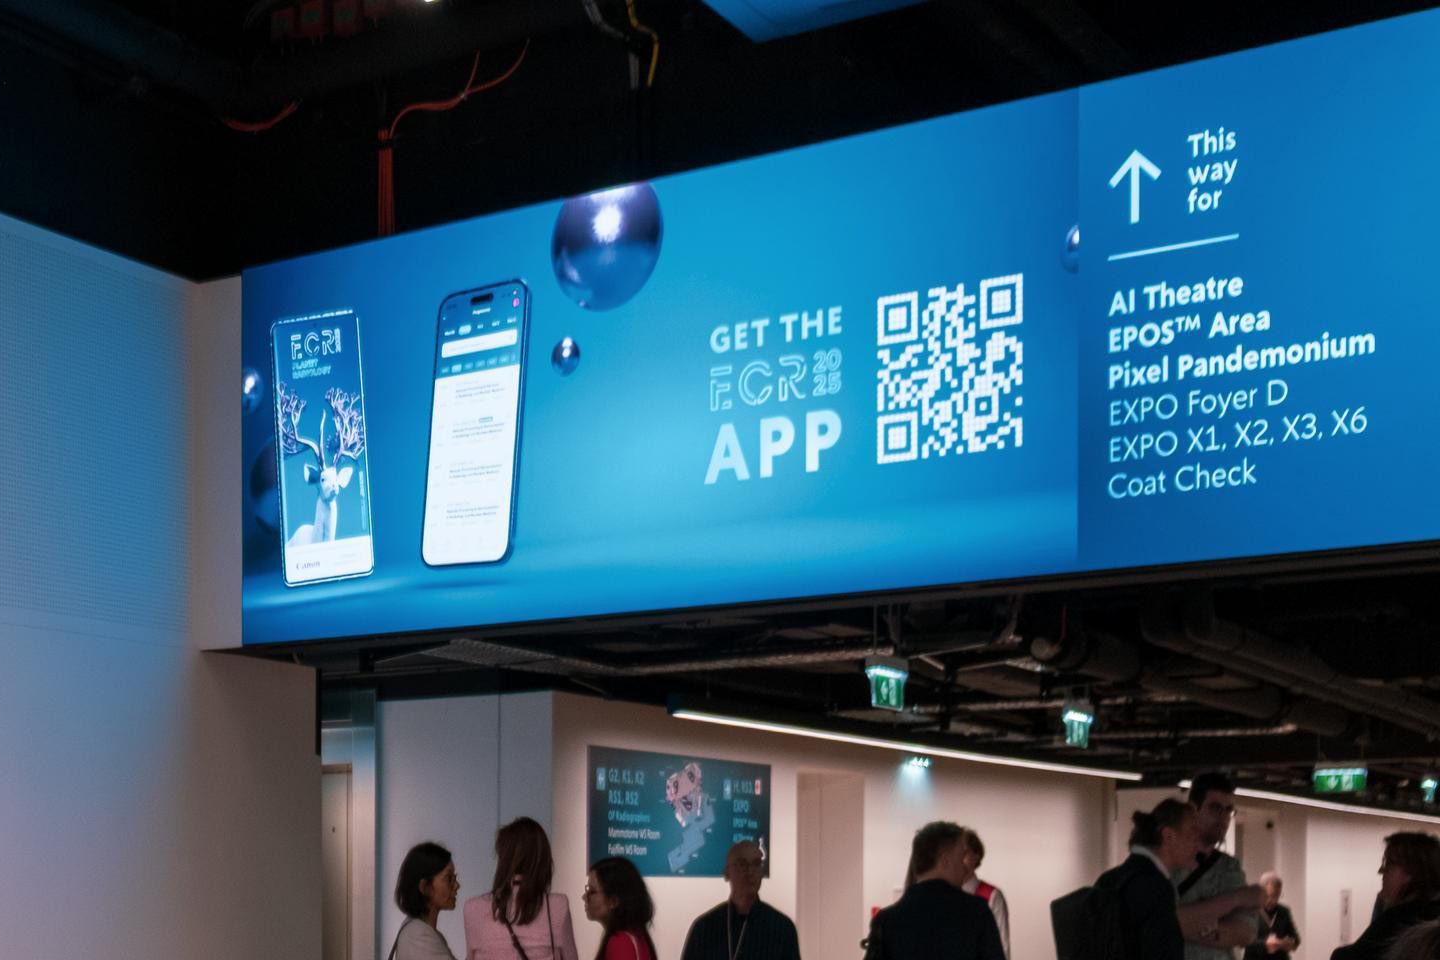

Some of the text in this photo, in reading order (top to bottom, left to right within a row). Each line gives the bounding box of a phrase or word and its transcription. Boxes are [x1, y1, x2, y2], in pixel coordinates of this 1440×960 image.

[1187, 126, 1236, 158] This
[1187, 158, 1238, 186] way
[1187, 187, 1223, 214] for
[1108, 275, 1244, 317] AI Theatre
[709, 305, 842, 354] GET THE
[1208, 310, 1271, 339] Area
[1108, 331, 1376, 390] Pixel Pandemonium
[1109, 379, 1289, 427] EXPO Foyer D
[704, 410, 842, 485] APP
[1109, 405, 1368, 464] EXPO X1, X2, X3, X6
[1107, 456, 1257, 499] Coat Check
